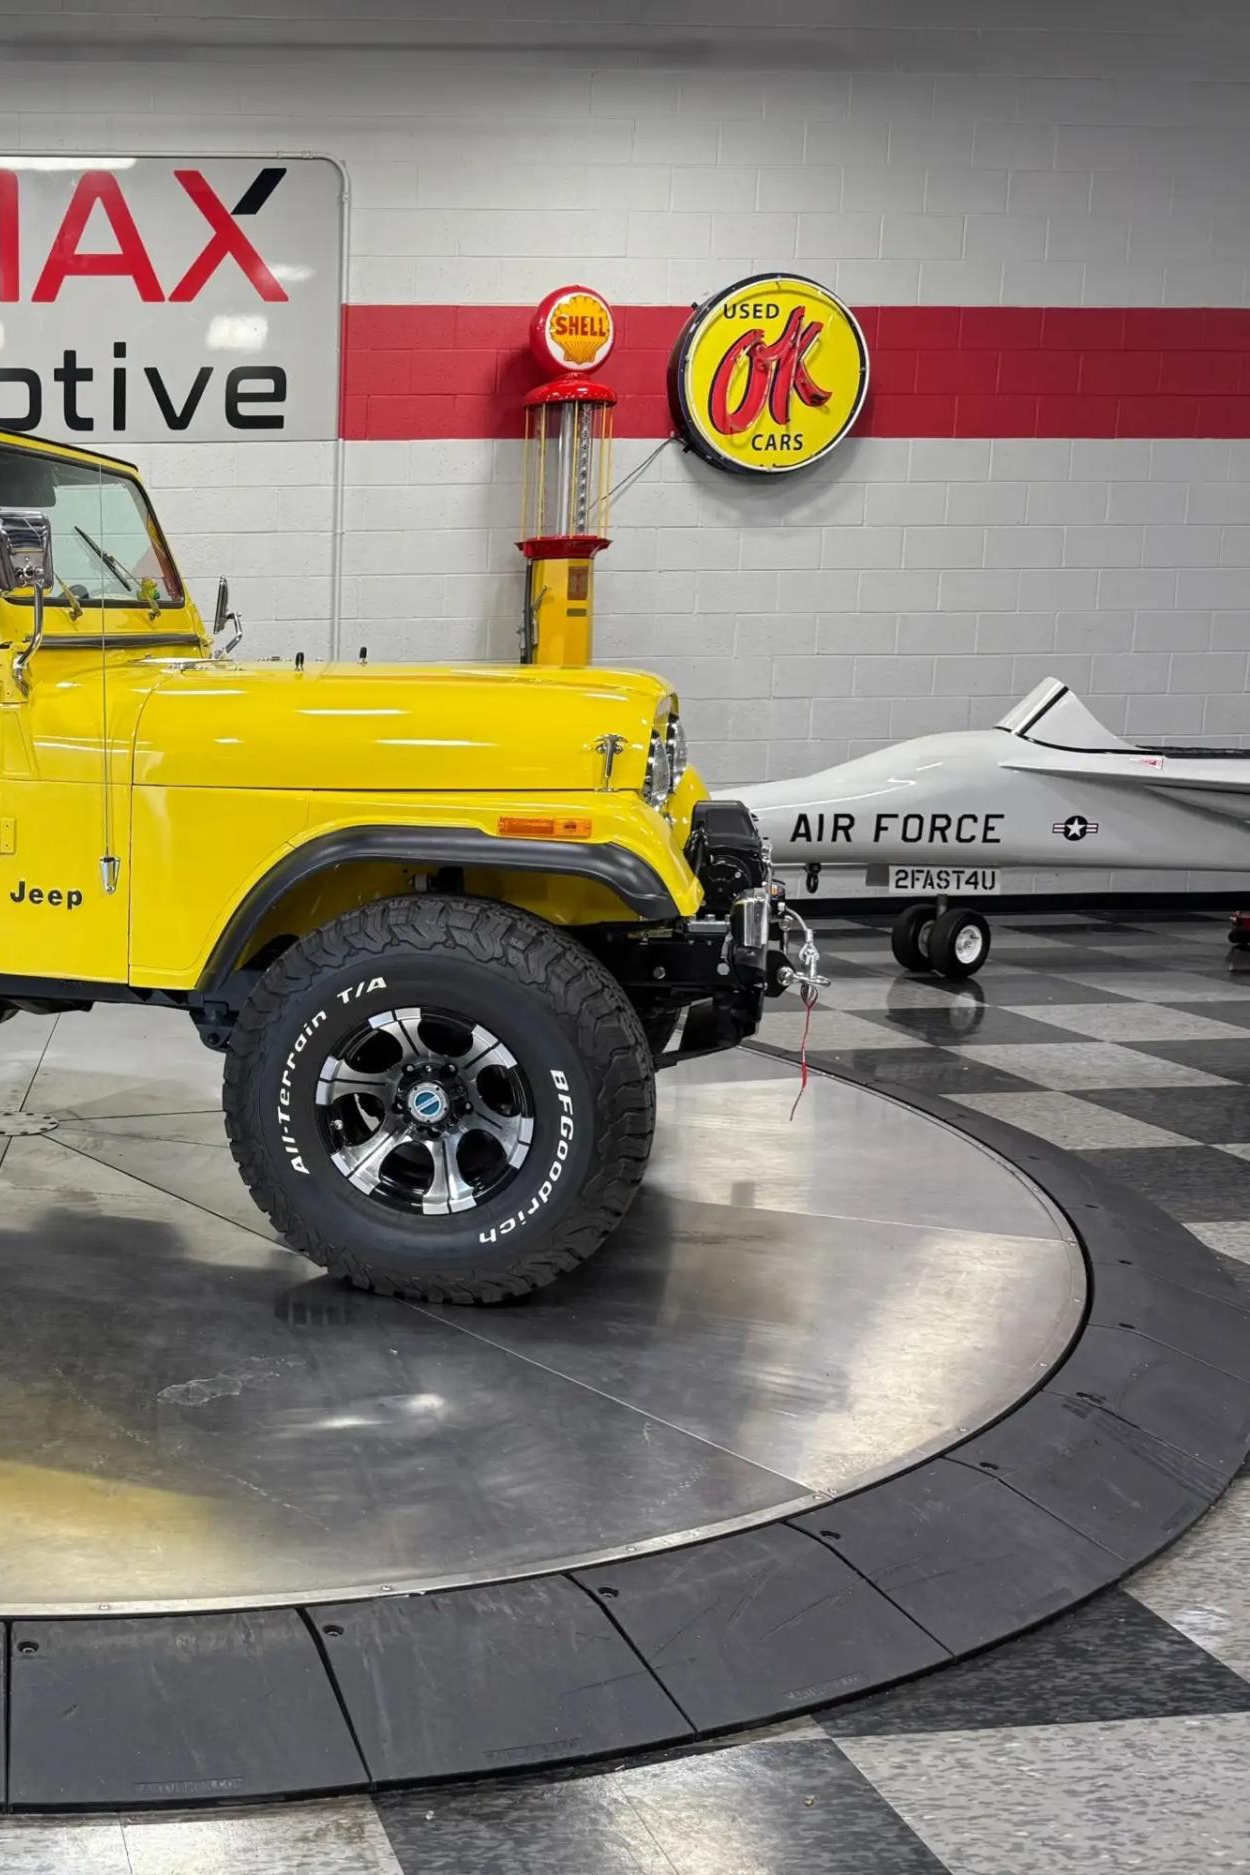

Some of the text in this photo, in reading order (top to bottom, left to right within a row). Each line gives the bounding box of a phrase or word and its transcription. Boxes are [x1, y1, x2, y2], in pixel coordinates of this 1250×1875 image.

[555, 315, 606, 337] SHELL
[723, 303, 779, 319] USED
[708, 305, 833, 436] OK
[751, 434, 803, 451] CARS
[790, 813, 1005, 843] AIR FORCE
[894, 869, 996, 890] 2FAST4U
[10, 880, 83, 910] Jeep
[277, 975, 388, 1175] All-Terrain T/A
[478, 1069, 574, 1244] BFGoodrich
